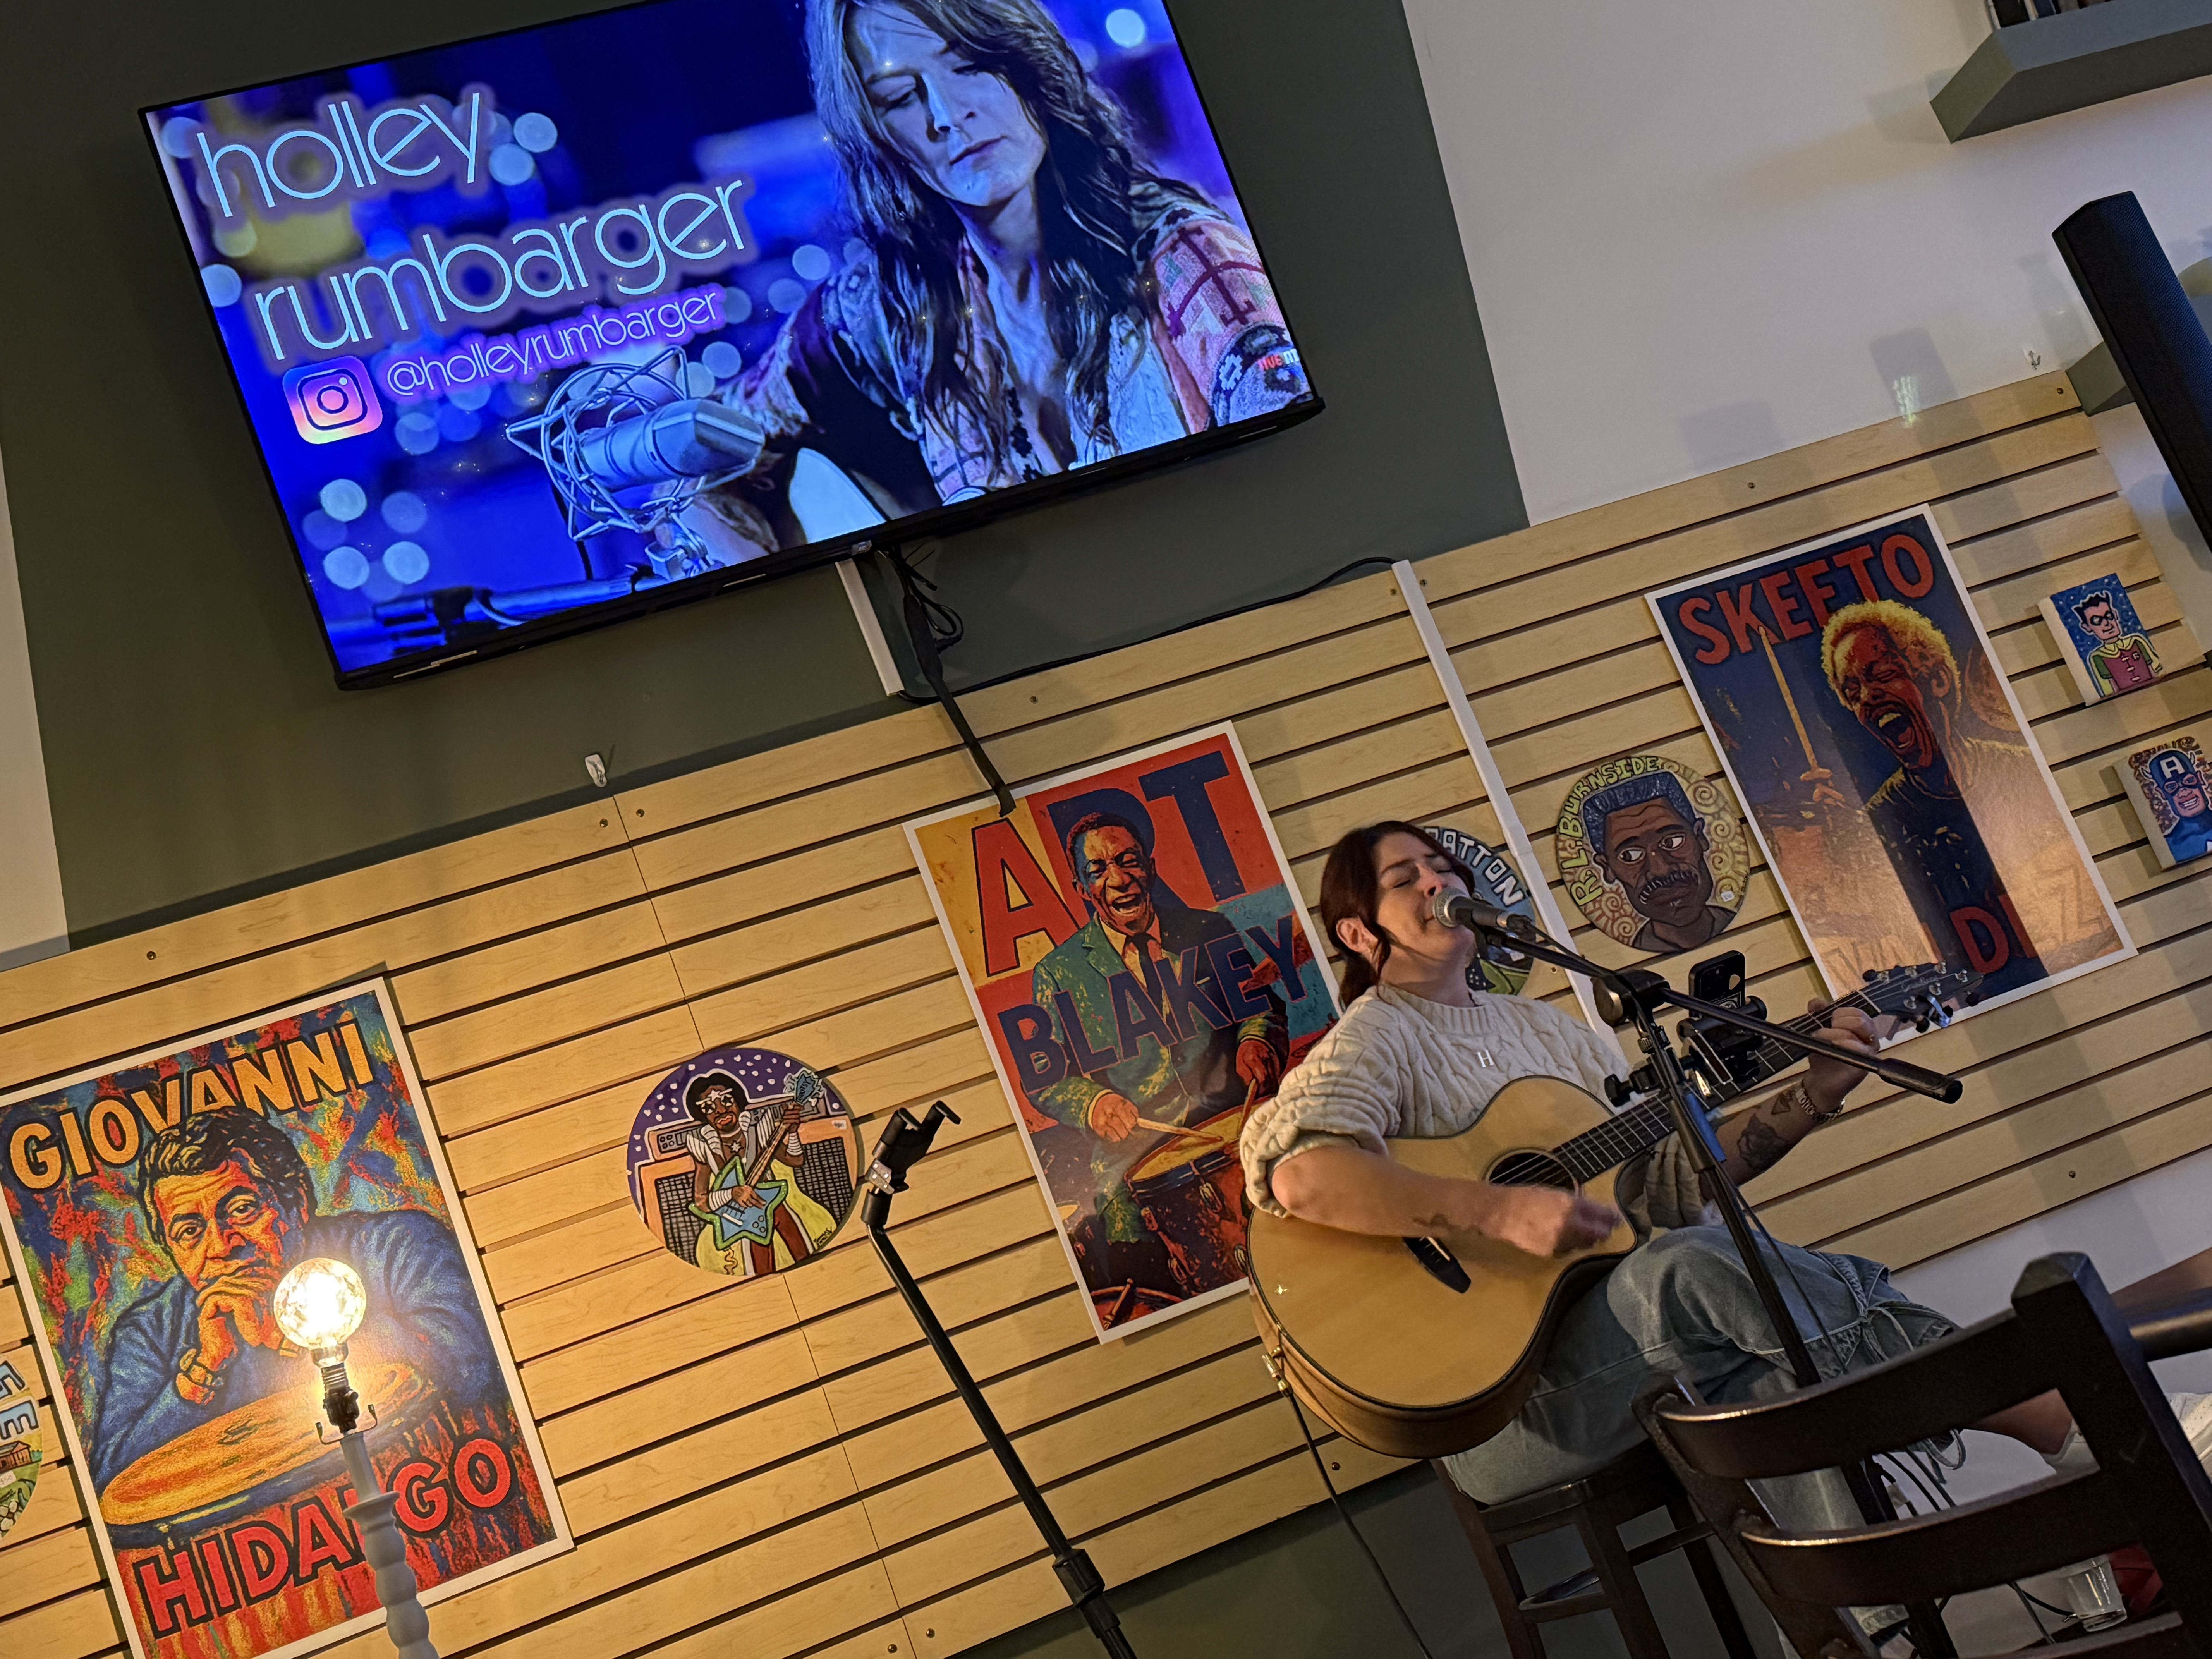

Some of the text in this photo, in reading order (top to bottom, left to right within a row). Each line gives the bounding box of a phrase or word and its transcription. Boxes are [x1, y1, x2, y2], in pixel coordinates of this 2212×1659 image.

[197, 92, 480, 218] holley
[255, 180, 745, 360] rumbarger
[386, 292, 717, 396] @holleyrumbarger
[1559, 756, 1659, 838] BURNSIDE
[998, 914, 1308, 1094] BLAKEY
[9, 1020, 375, 1190] GIOVANNI
